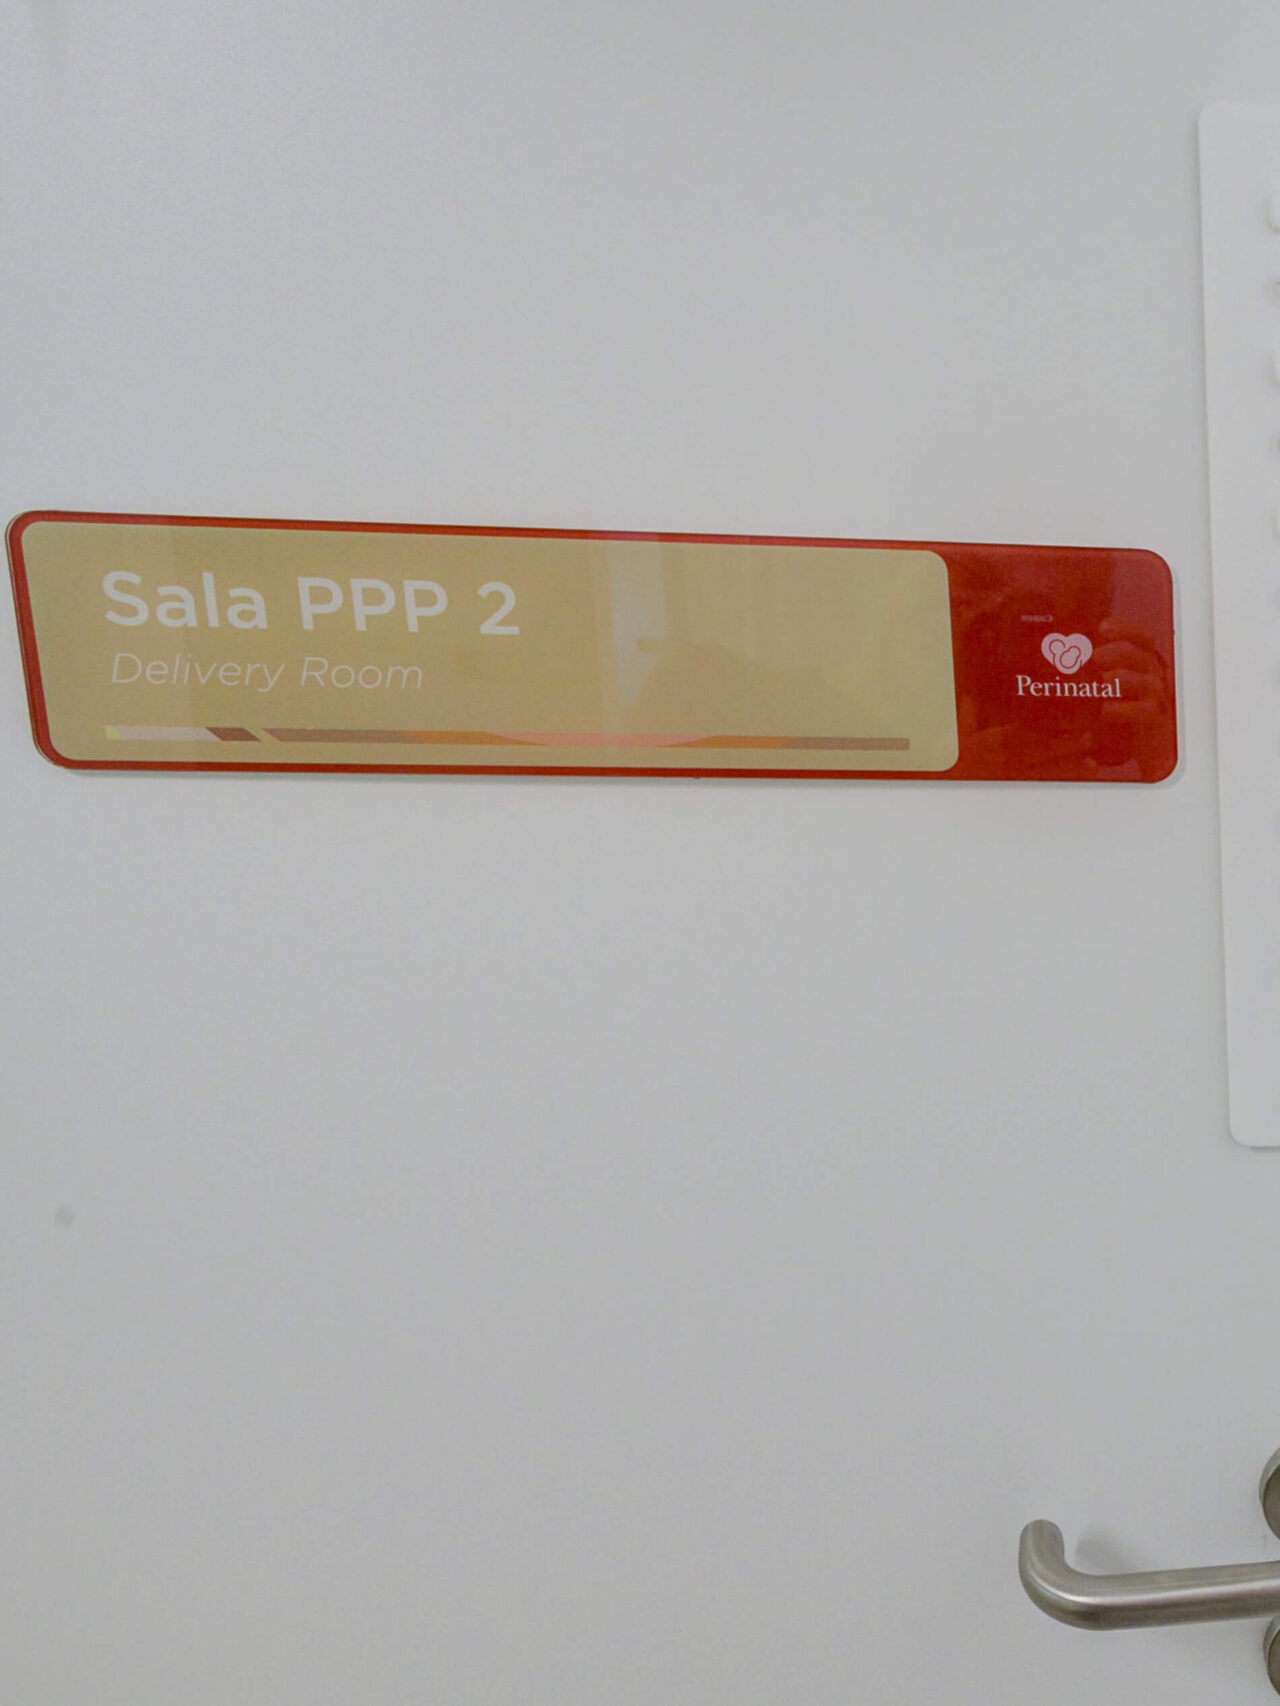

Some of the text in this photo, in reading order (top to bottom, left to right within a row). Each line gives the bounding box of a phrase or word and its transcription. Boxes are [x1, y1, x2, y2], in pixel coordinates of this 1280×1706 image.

[102, 570, 521, 635] Sala PPP 2
[111, 652, 424, 693] Delivery Room
[1015, 674, 1122, 698] Perinatal
